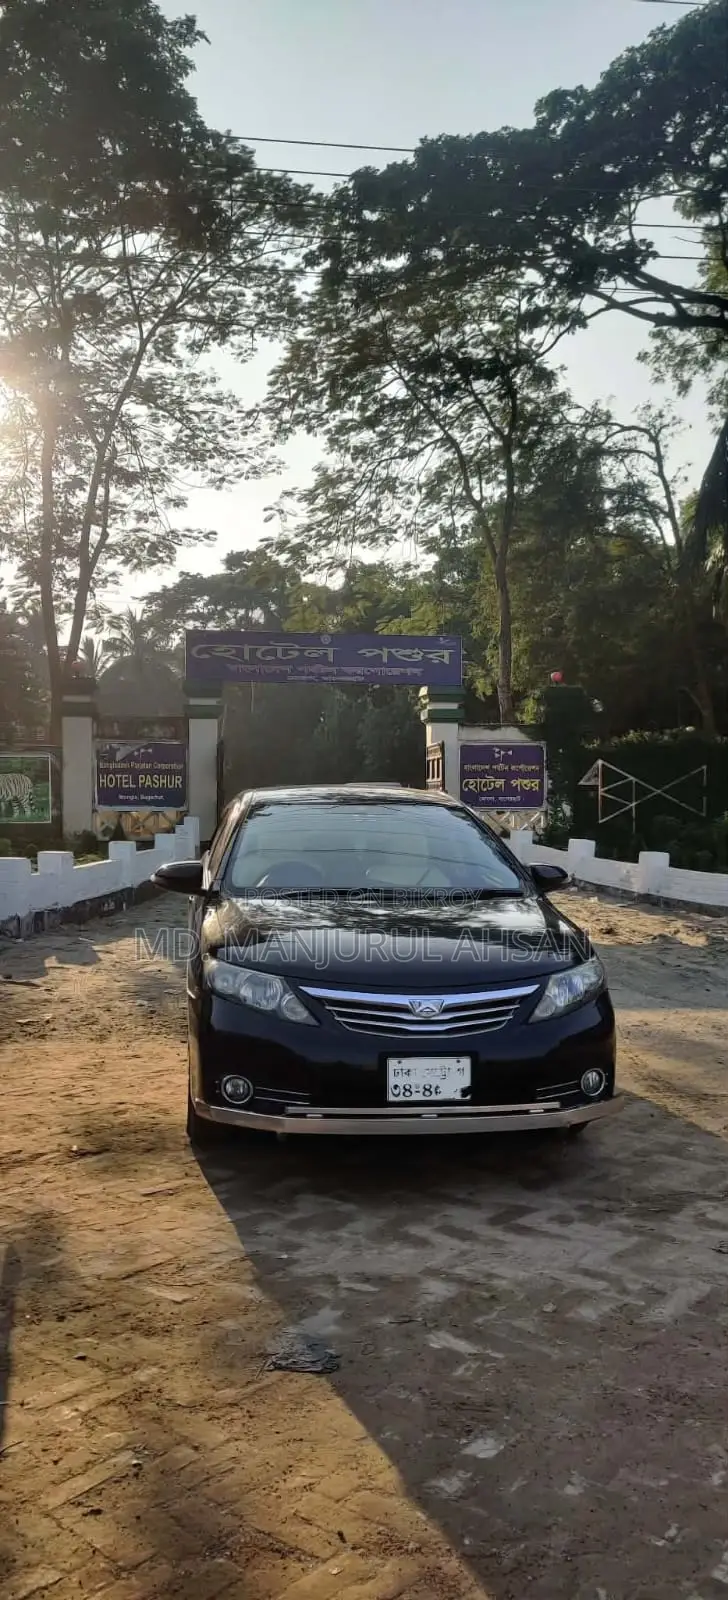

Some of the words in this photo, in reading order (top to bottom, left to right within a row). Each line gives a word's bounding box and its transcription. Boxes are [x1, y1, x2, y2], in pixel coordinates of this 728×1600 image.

[190, 641, 339, 664] হোটেল
[357, 646, 457, 666] পশুর
[99, 774, 136, 789] HOTEL
[138, 774, 182, 789] PASHUR
[462, 774, 506, 793] হোটেল
[510, 776, 541, 793] পশুর
